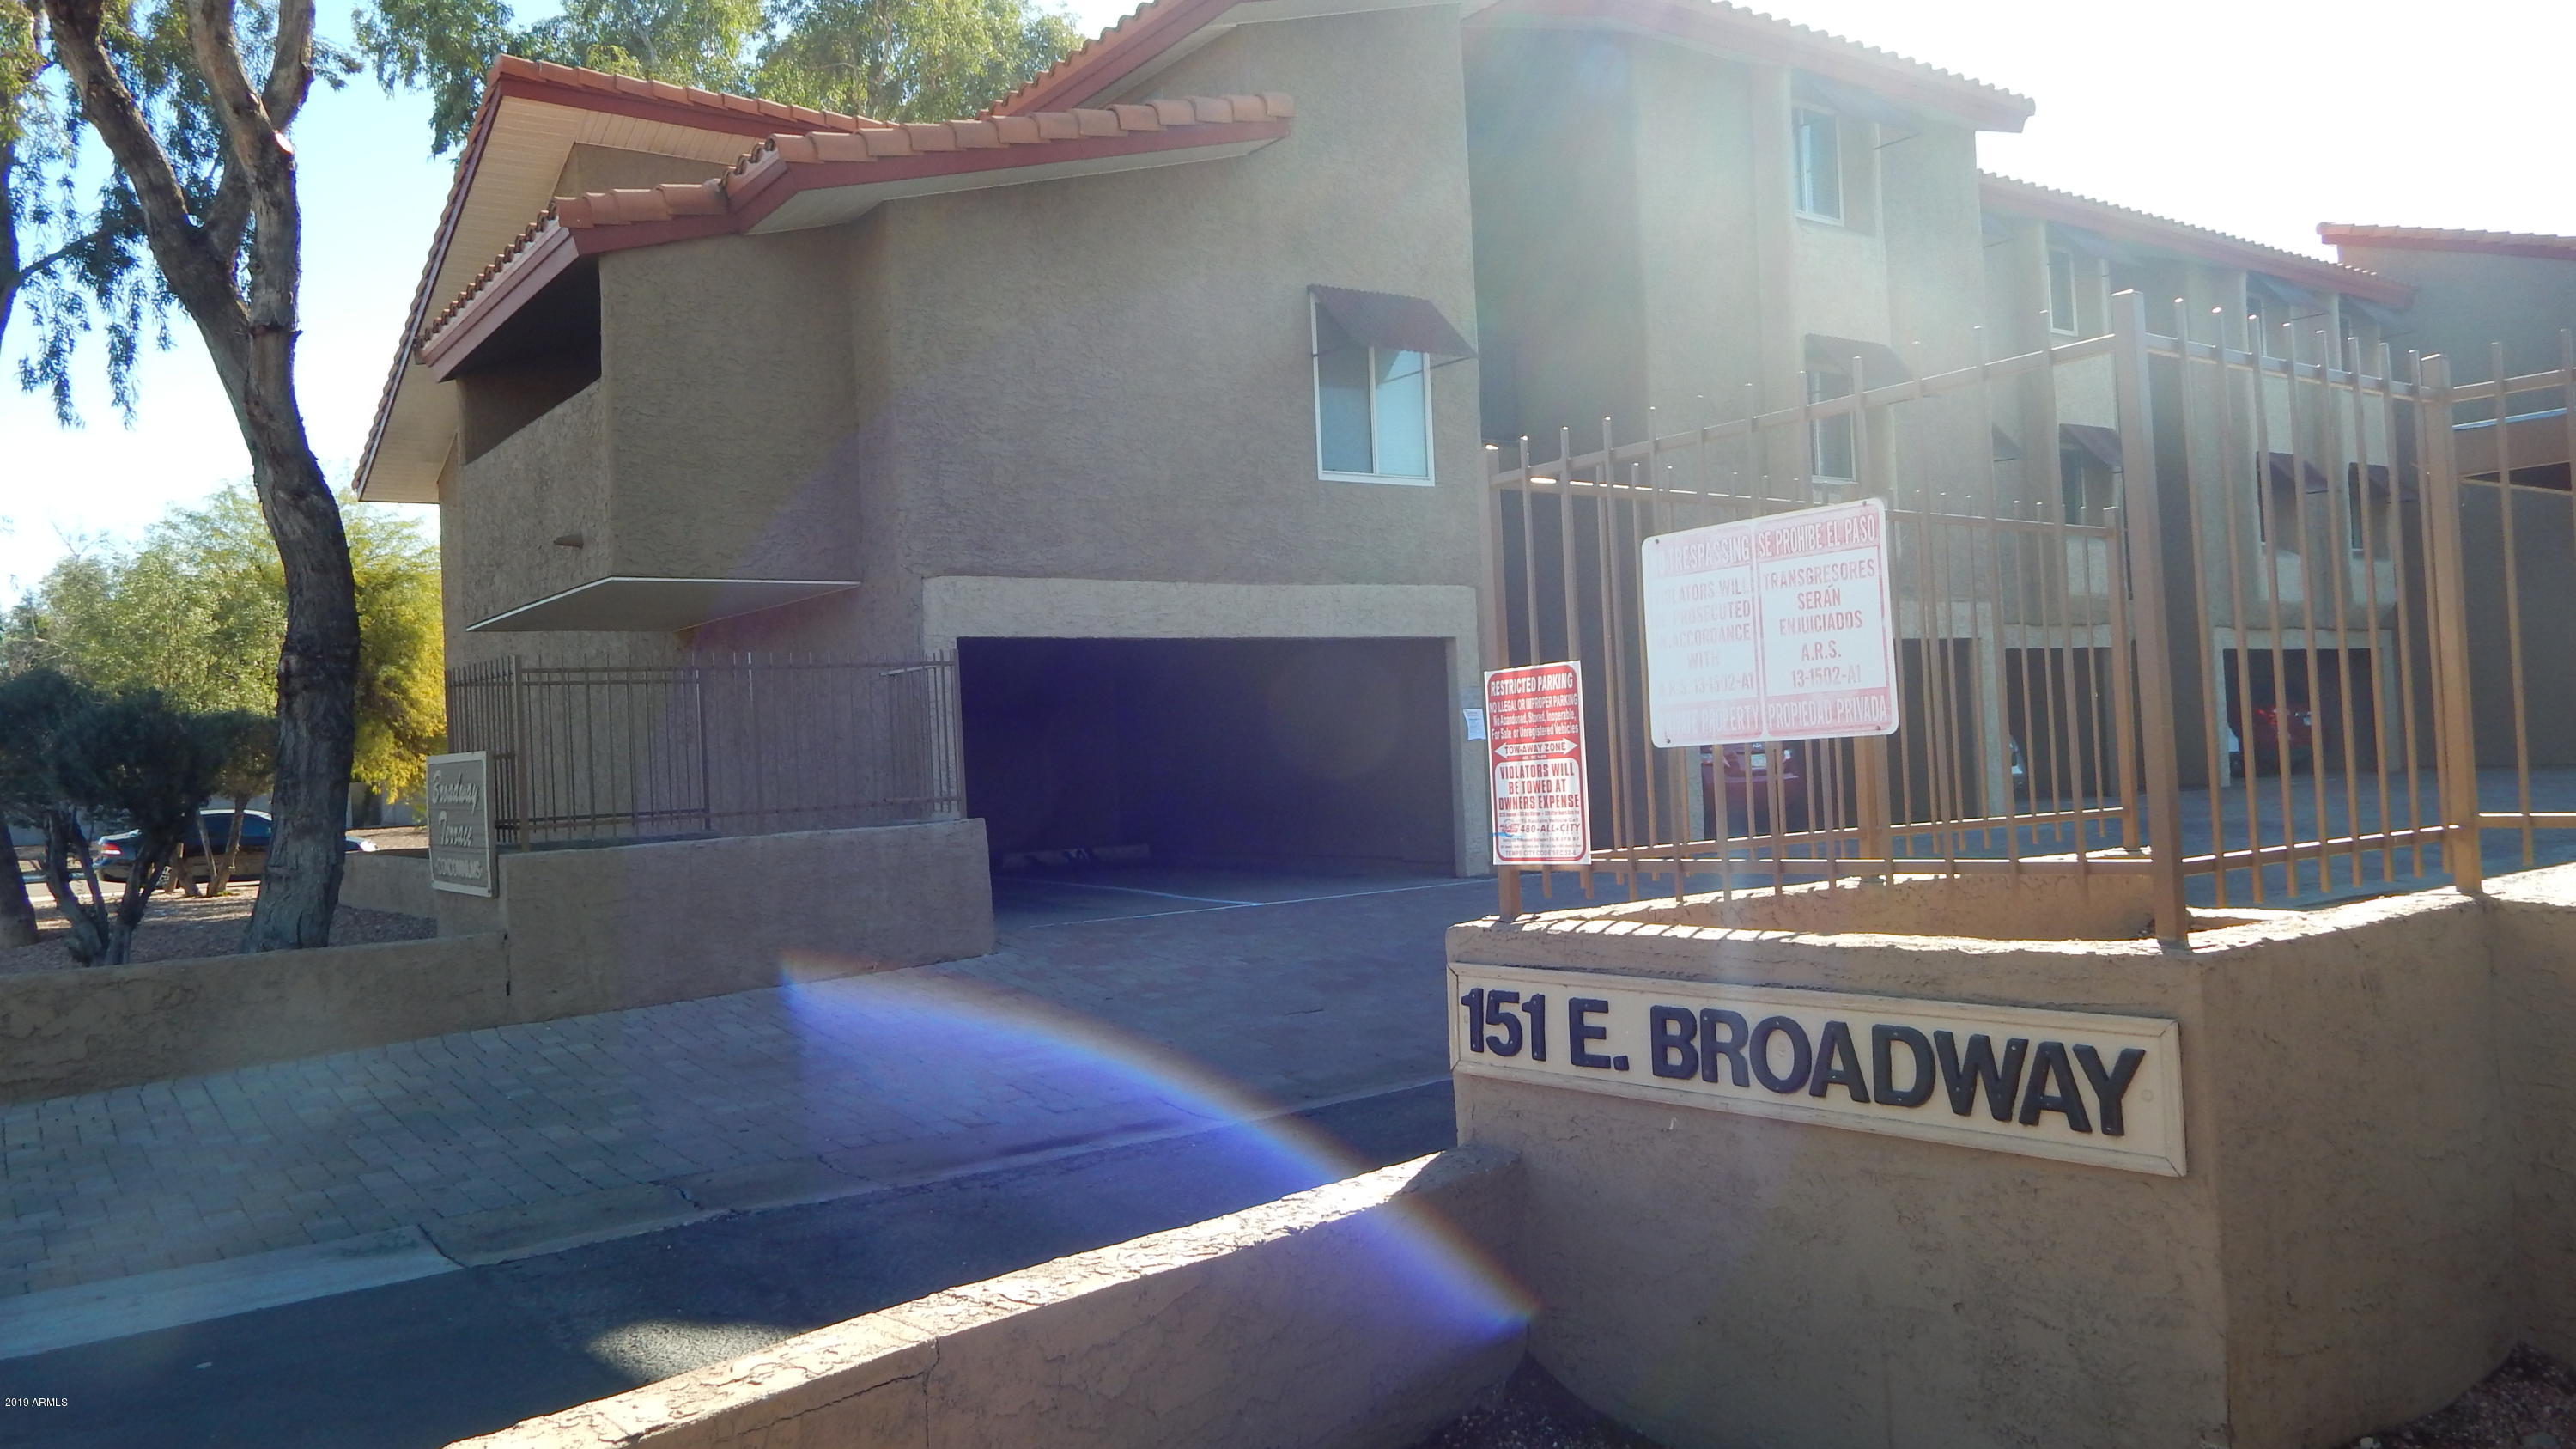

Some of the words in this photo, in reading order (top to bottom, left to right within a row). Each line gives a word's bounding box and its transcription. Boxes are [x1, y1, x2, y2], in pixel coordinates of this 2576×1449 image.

[1758, 529, 1773, 557] SE
[1775, 521, 1822, 555] PROHIBE
[1826, 519, 1842, 546] EL
[1845, 514, 1877, 544] PASO
[1668, 534, 1750, 573] TRESPASSING
[1763, 557, 1875, 591] TRANSGRESORES
[1653, 581, 1716, 606] OLATORS
[1797, 584, 1842, 611] SERÁN
[1779, 609, 1863, 636] ENJUICIADOS
[1687, 649, 1720, 670] WITH
[1801, 639, 1842, 661] A.R.S.
[1491, 676, 1537, 697] RESTRICTED
[1537, 672, 1573, 692] PARKING
[1791, 664, 1862, 689] 13-1502-A1
[1489, 701, 1497, 713] NO
[1497, 699, 1517, 713] ILLEGAL
[1517, 698, 1526, 710] OR
[1526, 696, 1552, 710] IMPROPER
[1553, 693, 1577, 707] PARKING
[1767, 699, 1832, 729] PROPIEDAD
[1837, 694, 1887, 723] PRIVADA
[1554, 721, 1579, 735] Vehicles
[1504, 743, 1542, 755] TOW-AWAY
[1545, 741, 1566, 752] ZONE
[1500, 764, 1549, 779] VIOLATORS
[1552, 762, 1574, 776] WILL
[432, 770, 480, 815] Broadway
[1509, 782, 1519, 795] BE
[1522, 779, 1552, 794] TOWED
[1555, 778, 1566, 792] AT
[1498, 795, 1535, 811] OWNERS
[1538, 793, 1579, 808] EXPENSE
[1520, 823, 1580, 833] 480-ALL-CITY
[1461, 986, 1546, 1062] 151
[1568, 997, 1630, 1072] E.
[1649, 1004, 2146, 1138] BROADWAY
